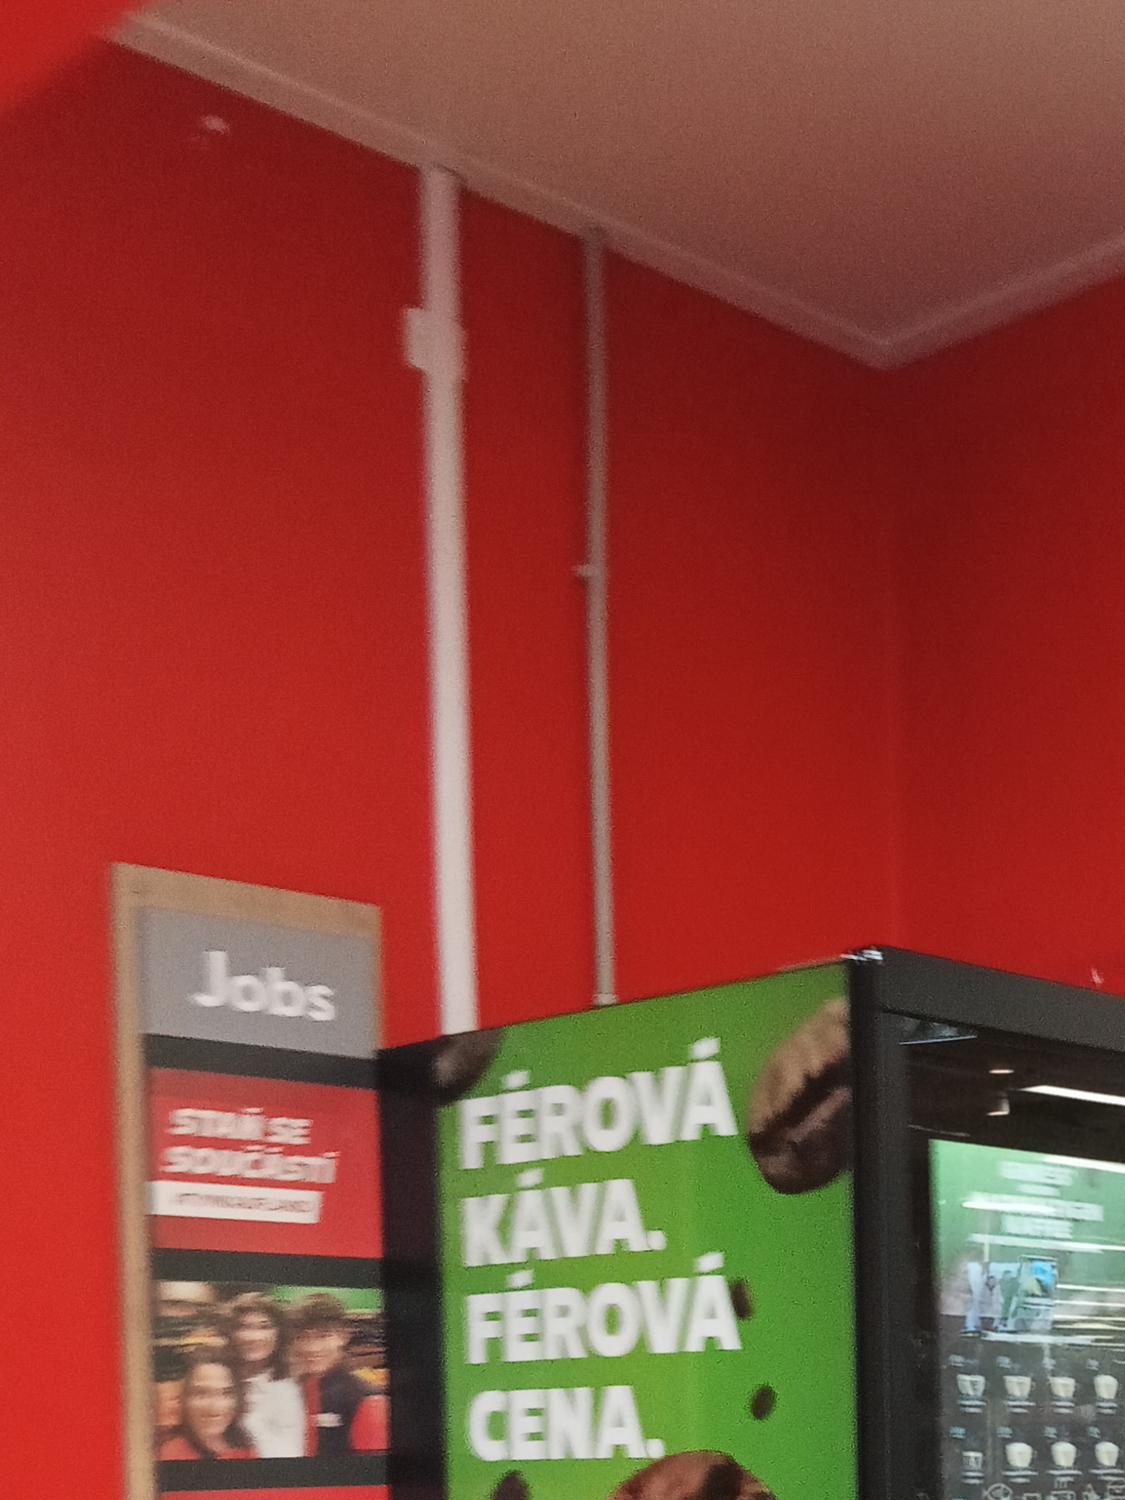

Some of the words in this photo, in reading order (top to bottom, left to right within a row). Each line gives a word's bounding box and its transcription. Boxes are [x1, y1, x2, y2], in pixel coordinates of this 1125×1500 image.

[186, 949, 337, 1021] Jobs
[459, 1037, 739, 1169] FÉROVÁ
[462, 1168, 668, 1267] KÁVA.
[464, 1252, 743, 1364] FÉROVÁ
[467, 1384, 667, 1462] CENA.
